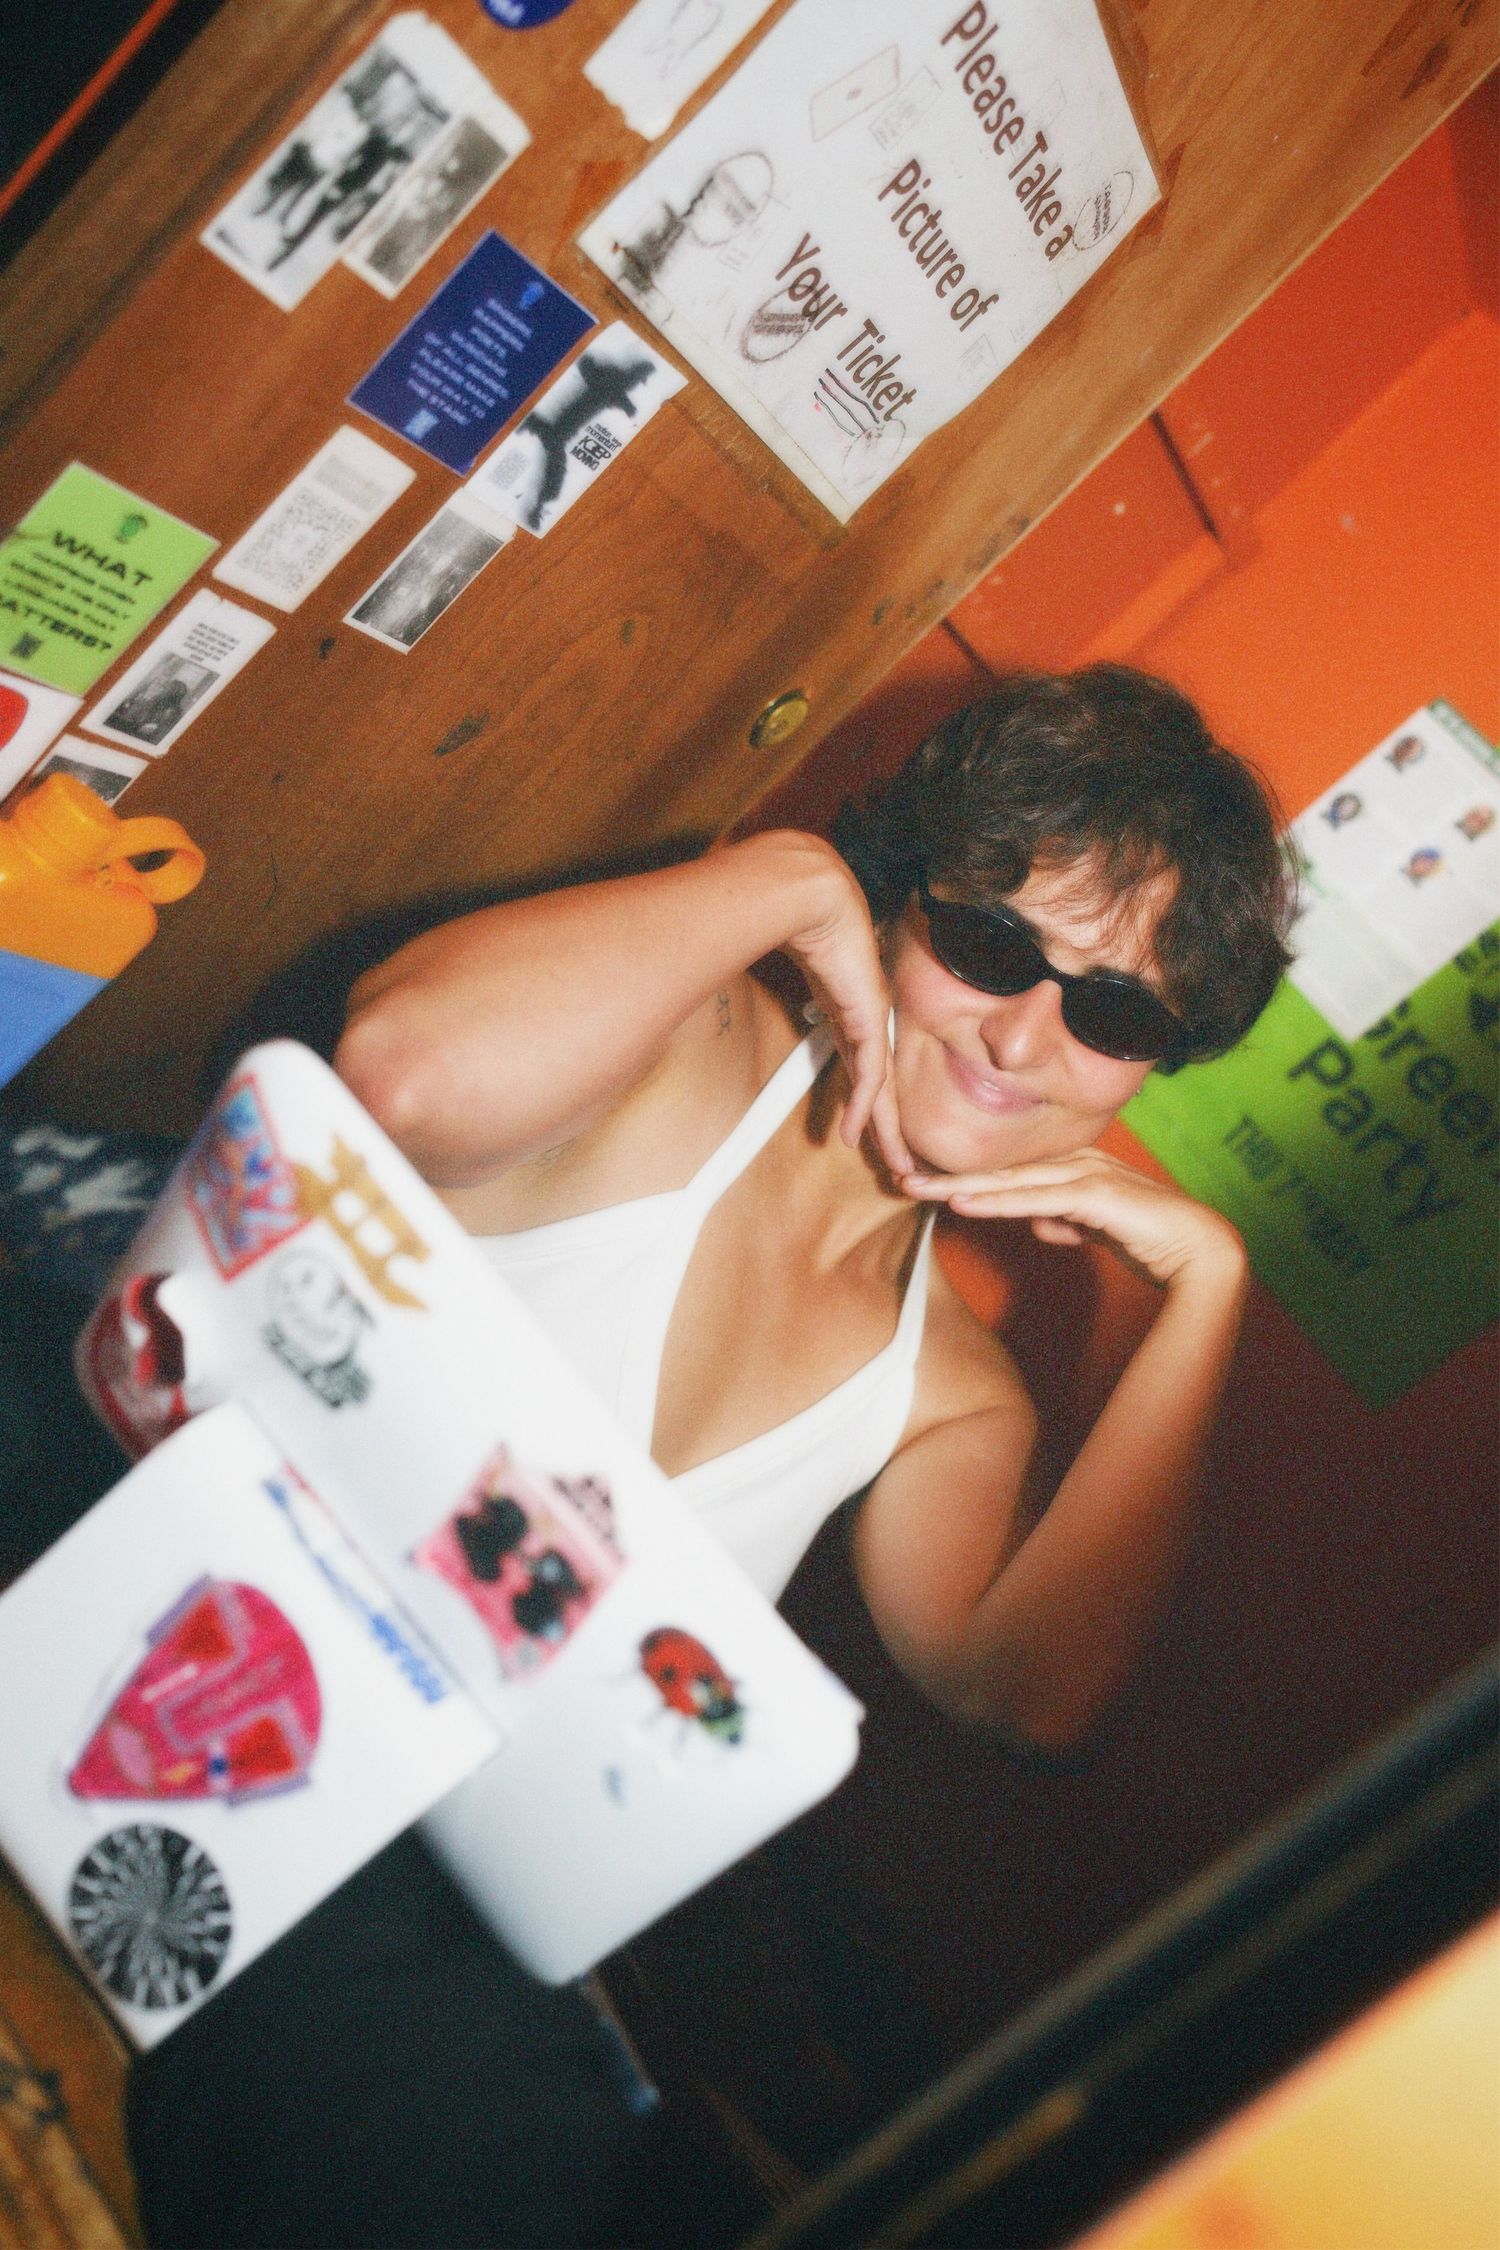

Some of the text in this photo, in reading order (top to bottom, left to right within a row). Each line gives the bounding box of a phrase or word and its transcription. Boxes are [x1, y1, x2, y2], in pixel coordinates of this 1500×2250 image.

[941, 0, 1073, 262] Please Take a
[775, 233, 848, 331] Your
[836, 318, 917, 422] Ticket
[878, 159, 1000, 332] Picture of
[569, 445, 600, 471] MOVING
[0, 594, 113, 652] ATTERS?
[53, 530, 153, 586] WHAT
[1287, 1037, 1459, 1228] Party
